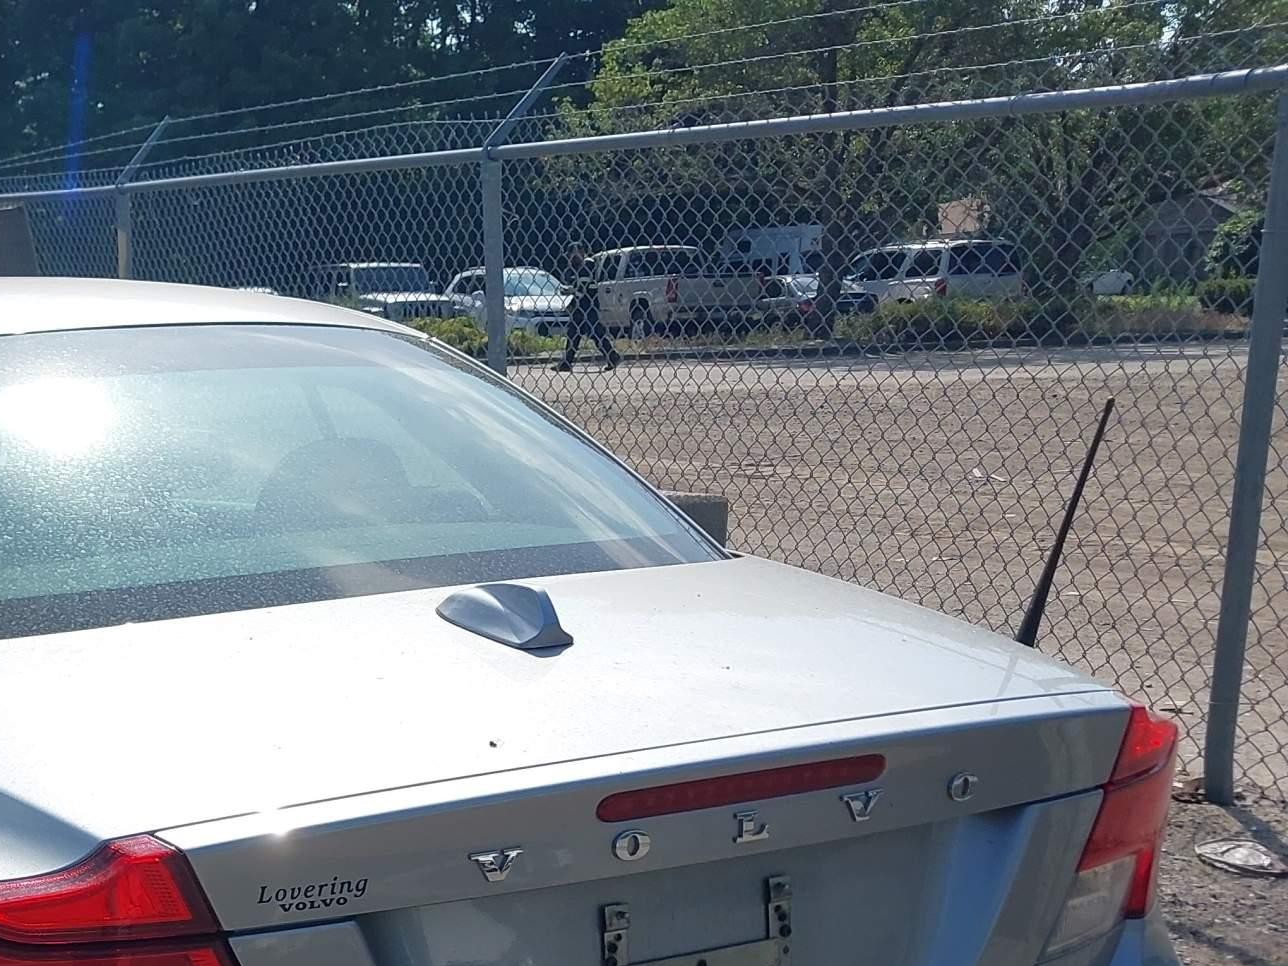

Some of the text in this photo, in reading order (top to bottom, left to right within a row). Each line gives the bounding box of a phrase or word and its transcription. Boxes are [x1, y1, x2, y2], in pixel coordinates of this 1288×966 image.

[467, 771, 979, 883] VOLVO
[257, 876, 368, 904] Lovering
[279, 896, 348, 913] VOLVO
